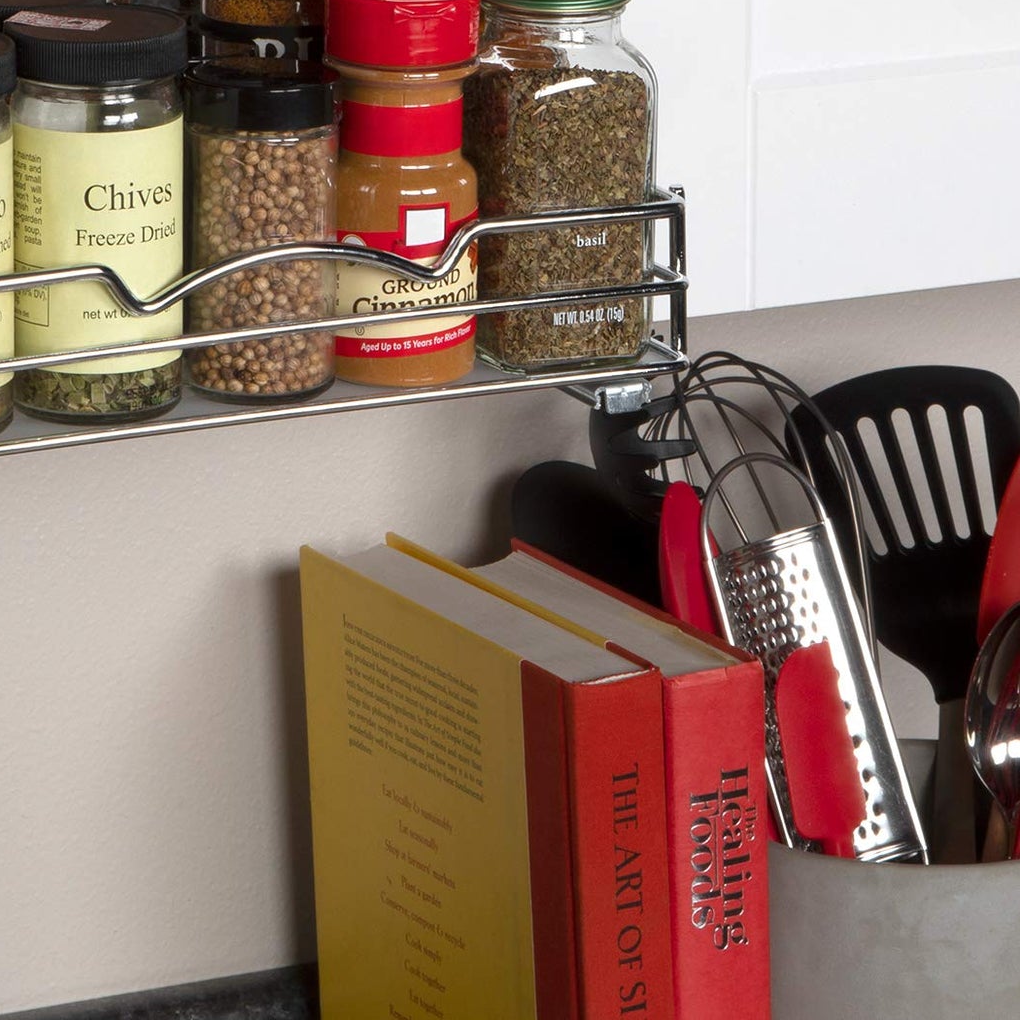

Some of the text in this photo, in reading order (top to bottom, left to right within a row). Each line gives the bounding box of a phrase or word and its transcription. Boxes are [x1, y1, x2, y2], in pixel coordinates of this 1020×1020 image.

[83, 181, 173, 213] Chives
[75, 217, 176, 247] Freeze Dried
[576, 232, 607, 248] basil
[382, 268, 460, 295] GROUND
[83, 308, 101, 320] net
[103, 308, 118, 320] wt
[553, 312, 566, 326] NET
[579, 309, 594, 323] 0.54
[607, 306, 625, 323] (15g)
[360, 331, 457, 353] Aged Up to 15 Years for Rich
[745, 800, 757, 841] The
[612, 762, 644, 971] THE ART OF
[690, 788, 722, 929] Foods
[713, 763, 753, 951] Healing
